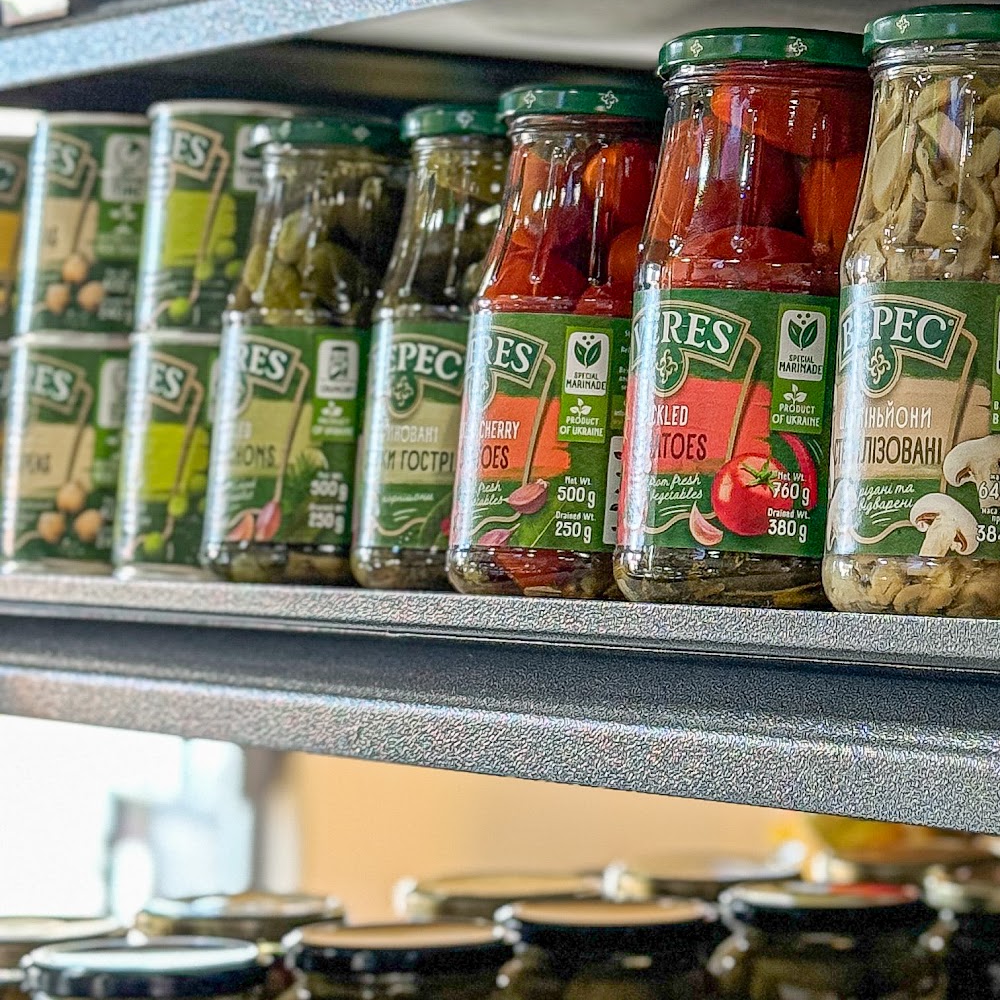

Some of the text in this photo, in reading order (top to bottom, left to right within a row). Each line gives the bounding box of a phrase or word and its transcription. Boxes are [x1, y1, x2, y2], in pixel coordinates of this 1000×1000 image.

[634, 310, 734, 355] VRES
[842, 306, 947, 356] ВРЕС
[388, 341, 462, 380] ЕРЕС
[480, 333, 533, 374] RES
[789, 354, 814, 364] SPECIAL
[238, 342, 288, 381] RES
[779, 361, 823, 375] MARINADE
[574, 371, 599, 381] SPECIAL
[566, 379, 607, 391] MARINADE
[651, 404, 689, 427] CKLED
[779, 403, 815, 414] PRODUCT
[864, 401, 932, 429] ІНЬЙОНИ
[565, 416, 599, 426] PRODUCT
[772, 413, 820, 427] OF UKRAINE
[480, 420, 521, 440] CHERRY
[559, 425, 604, 437] OF UKRAINE
[654, 432, 708, 461] TOES
[400, 450, 455, 473] ГОСТРІ
[565, 476, 579, 485] Net
[670, 472, 701, 490] fresh
[778, 472, 792, 481] Net
[555, 510, 581, 520] Drained
[767, 508, 795, 518] Drained
